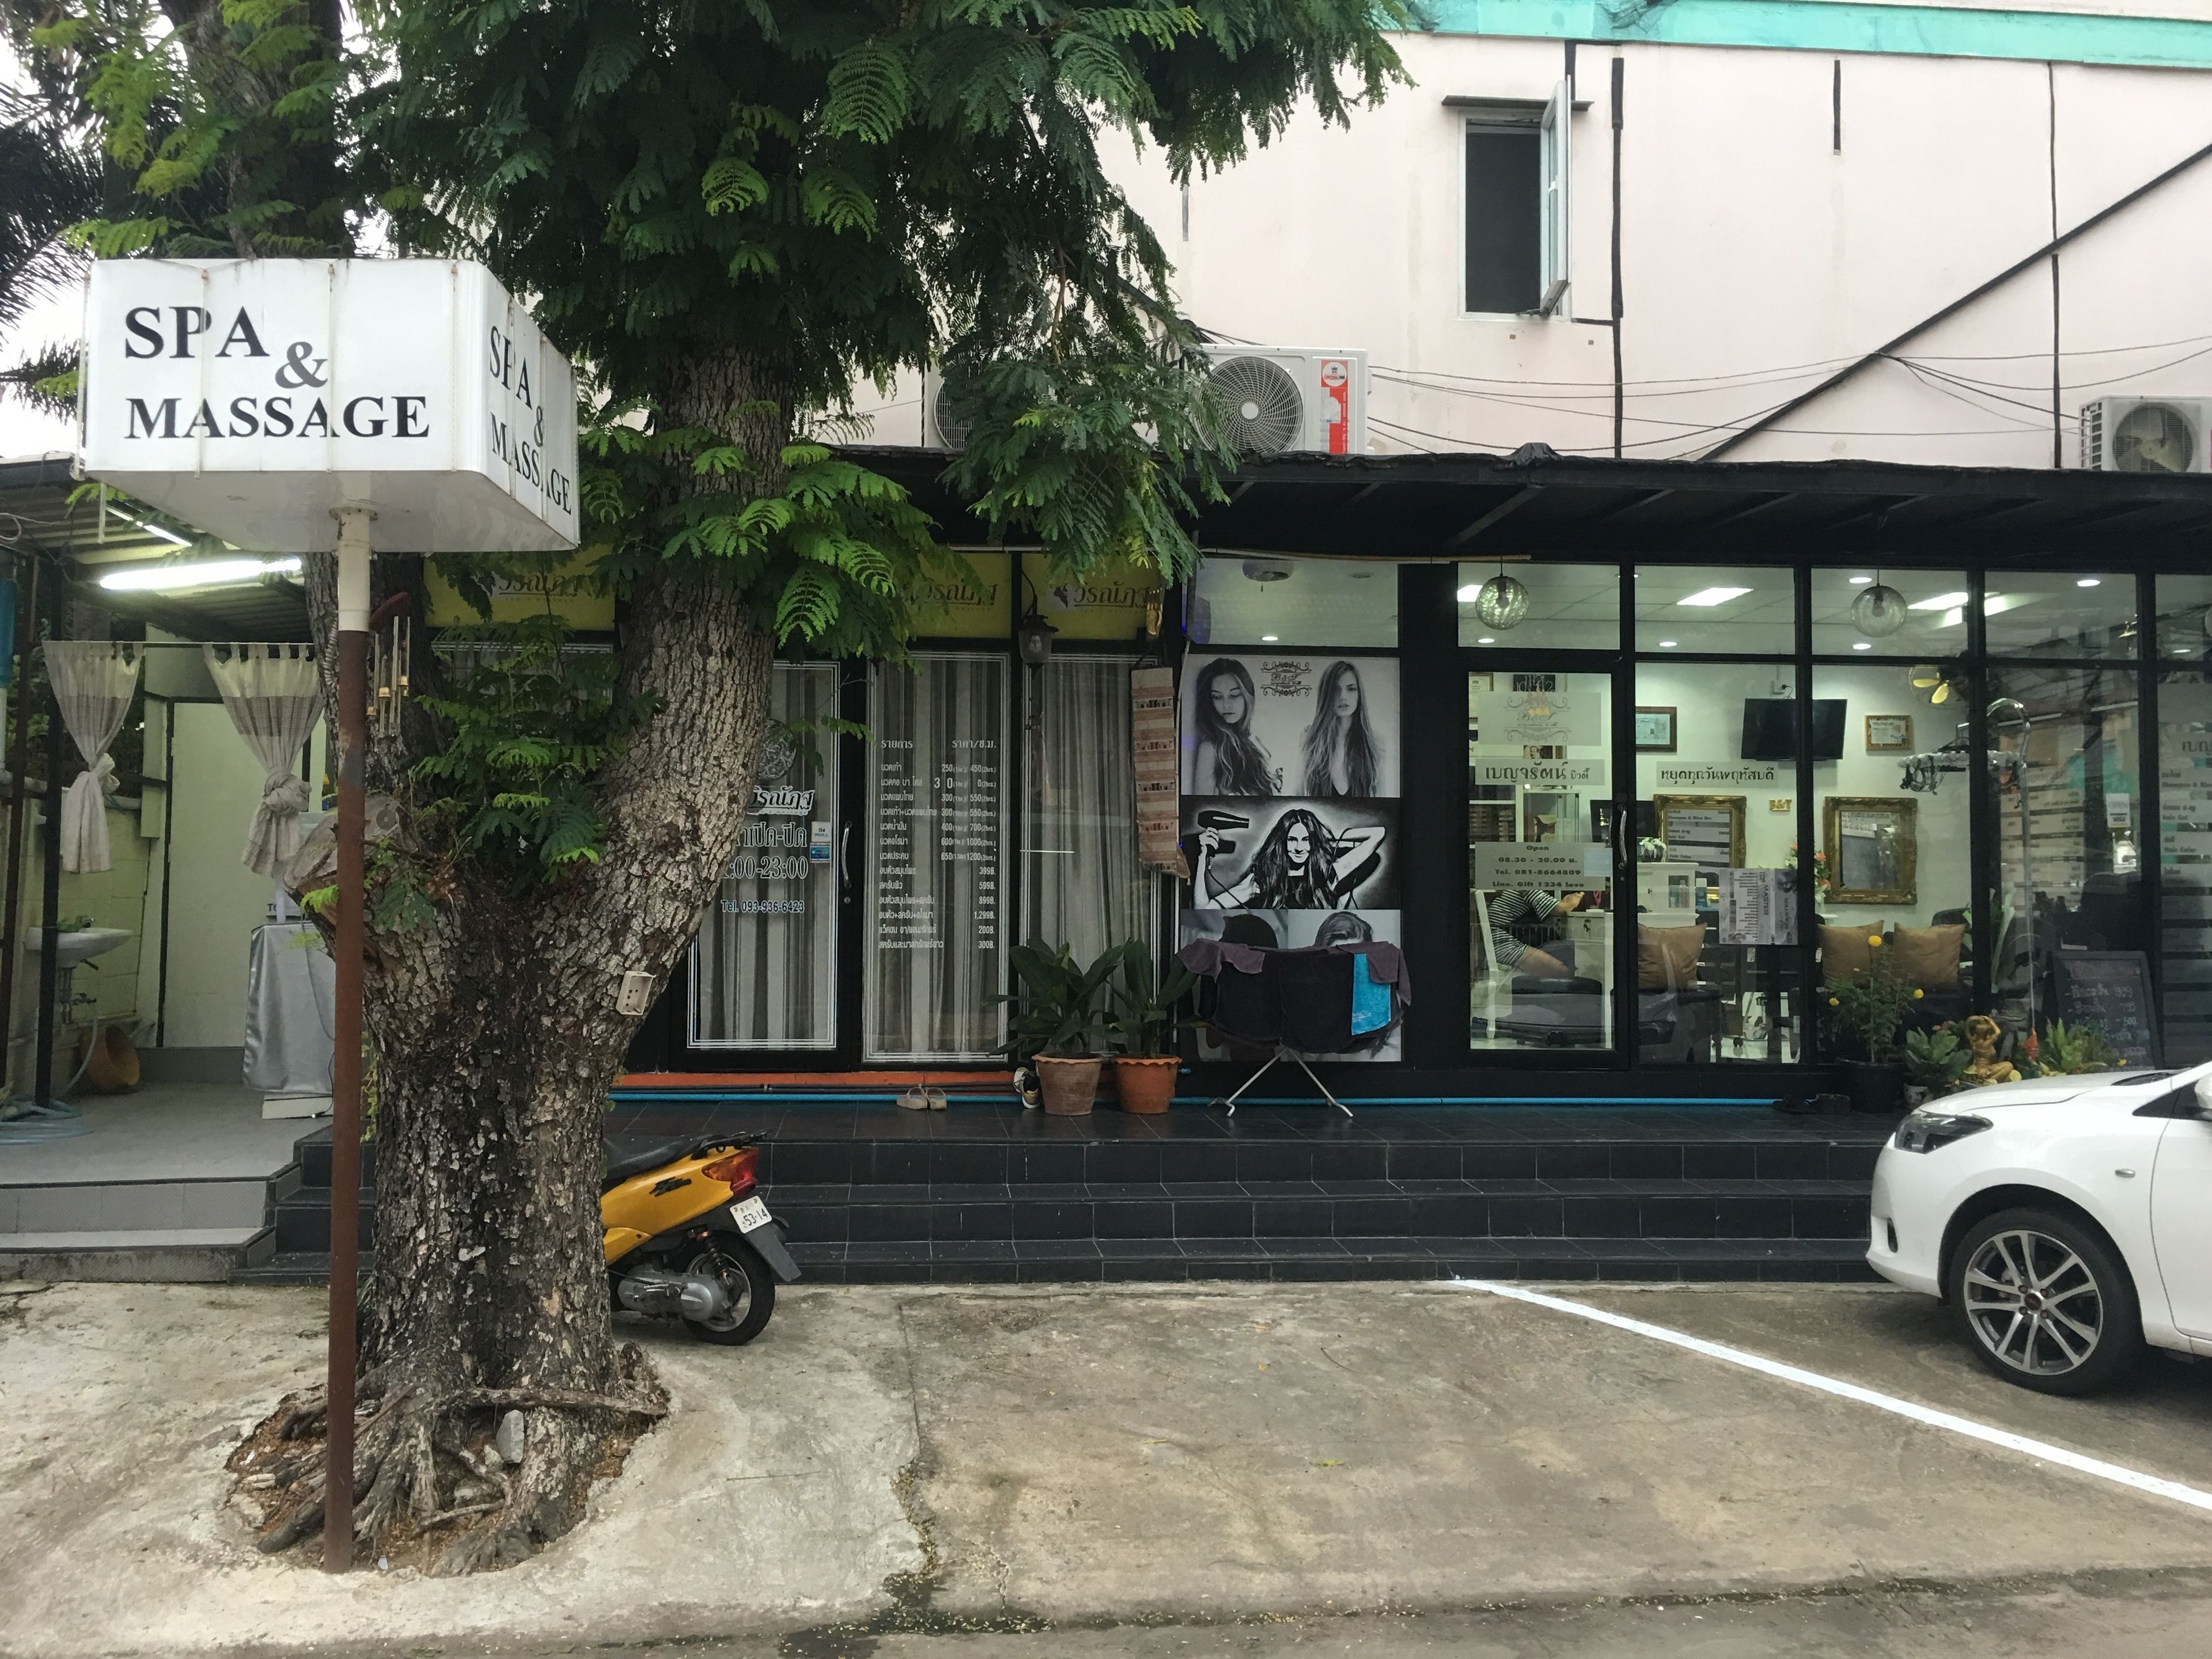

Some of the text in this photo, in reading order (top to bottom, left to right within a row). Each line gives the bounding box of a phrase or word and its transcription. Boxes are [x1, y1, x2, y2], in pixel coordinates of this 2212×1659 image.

[125, 305, 270, 358] SPA
[275, 341, 328, 389] &
[124, 395, 430, 440] MASSAGE
[881, 740, 913, 748] รายการ
[881, 762, 902, 772] นวดเท้า
[1486, 761, 1568, 782] เบญจรัตน์
[1661, 766, 1774, 785] หยุดทุกวันพฤหัสบดี
[736, 821, 807, 847] าเปิด-ปิด
[880, 852, 909, 860] นวดประคบ
[723, 856, 808, 879] :00-23:00
[721, 899, 805, 913] Tel. 093-936-6423
